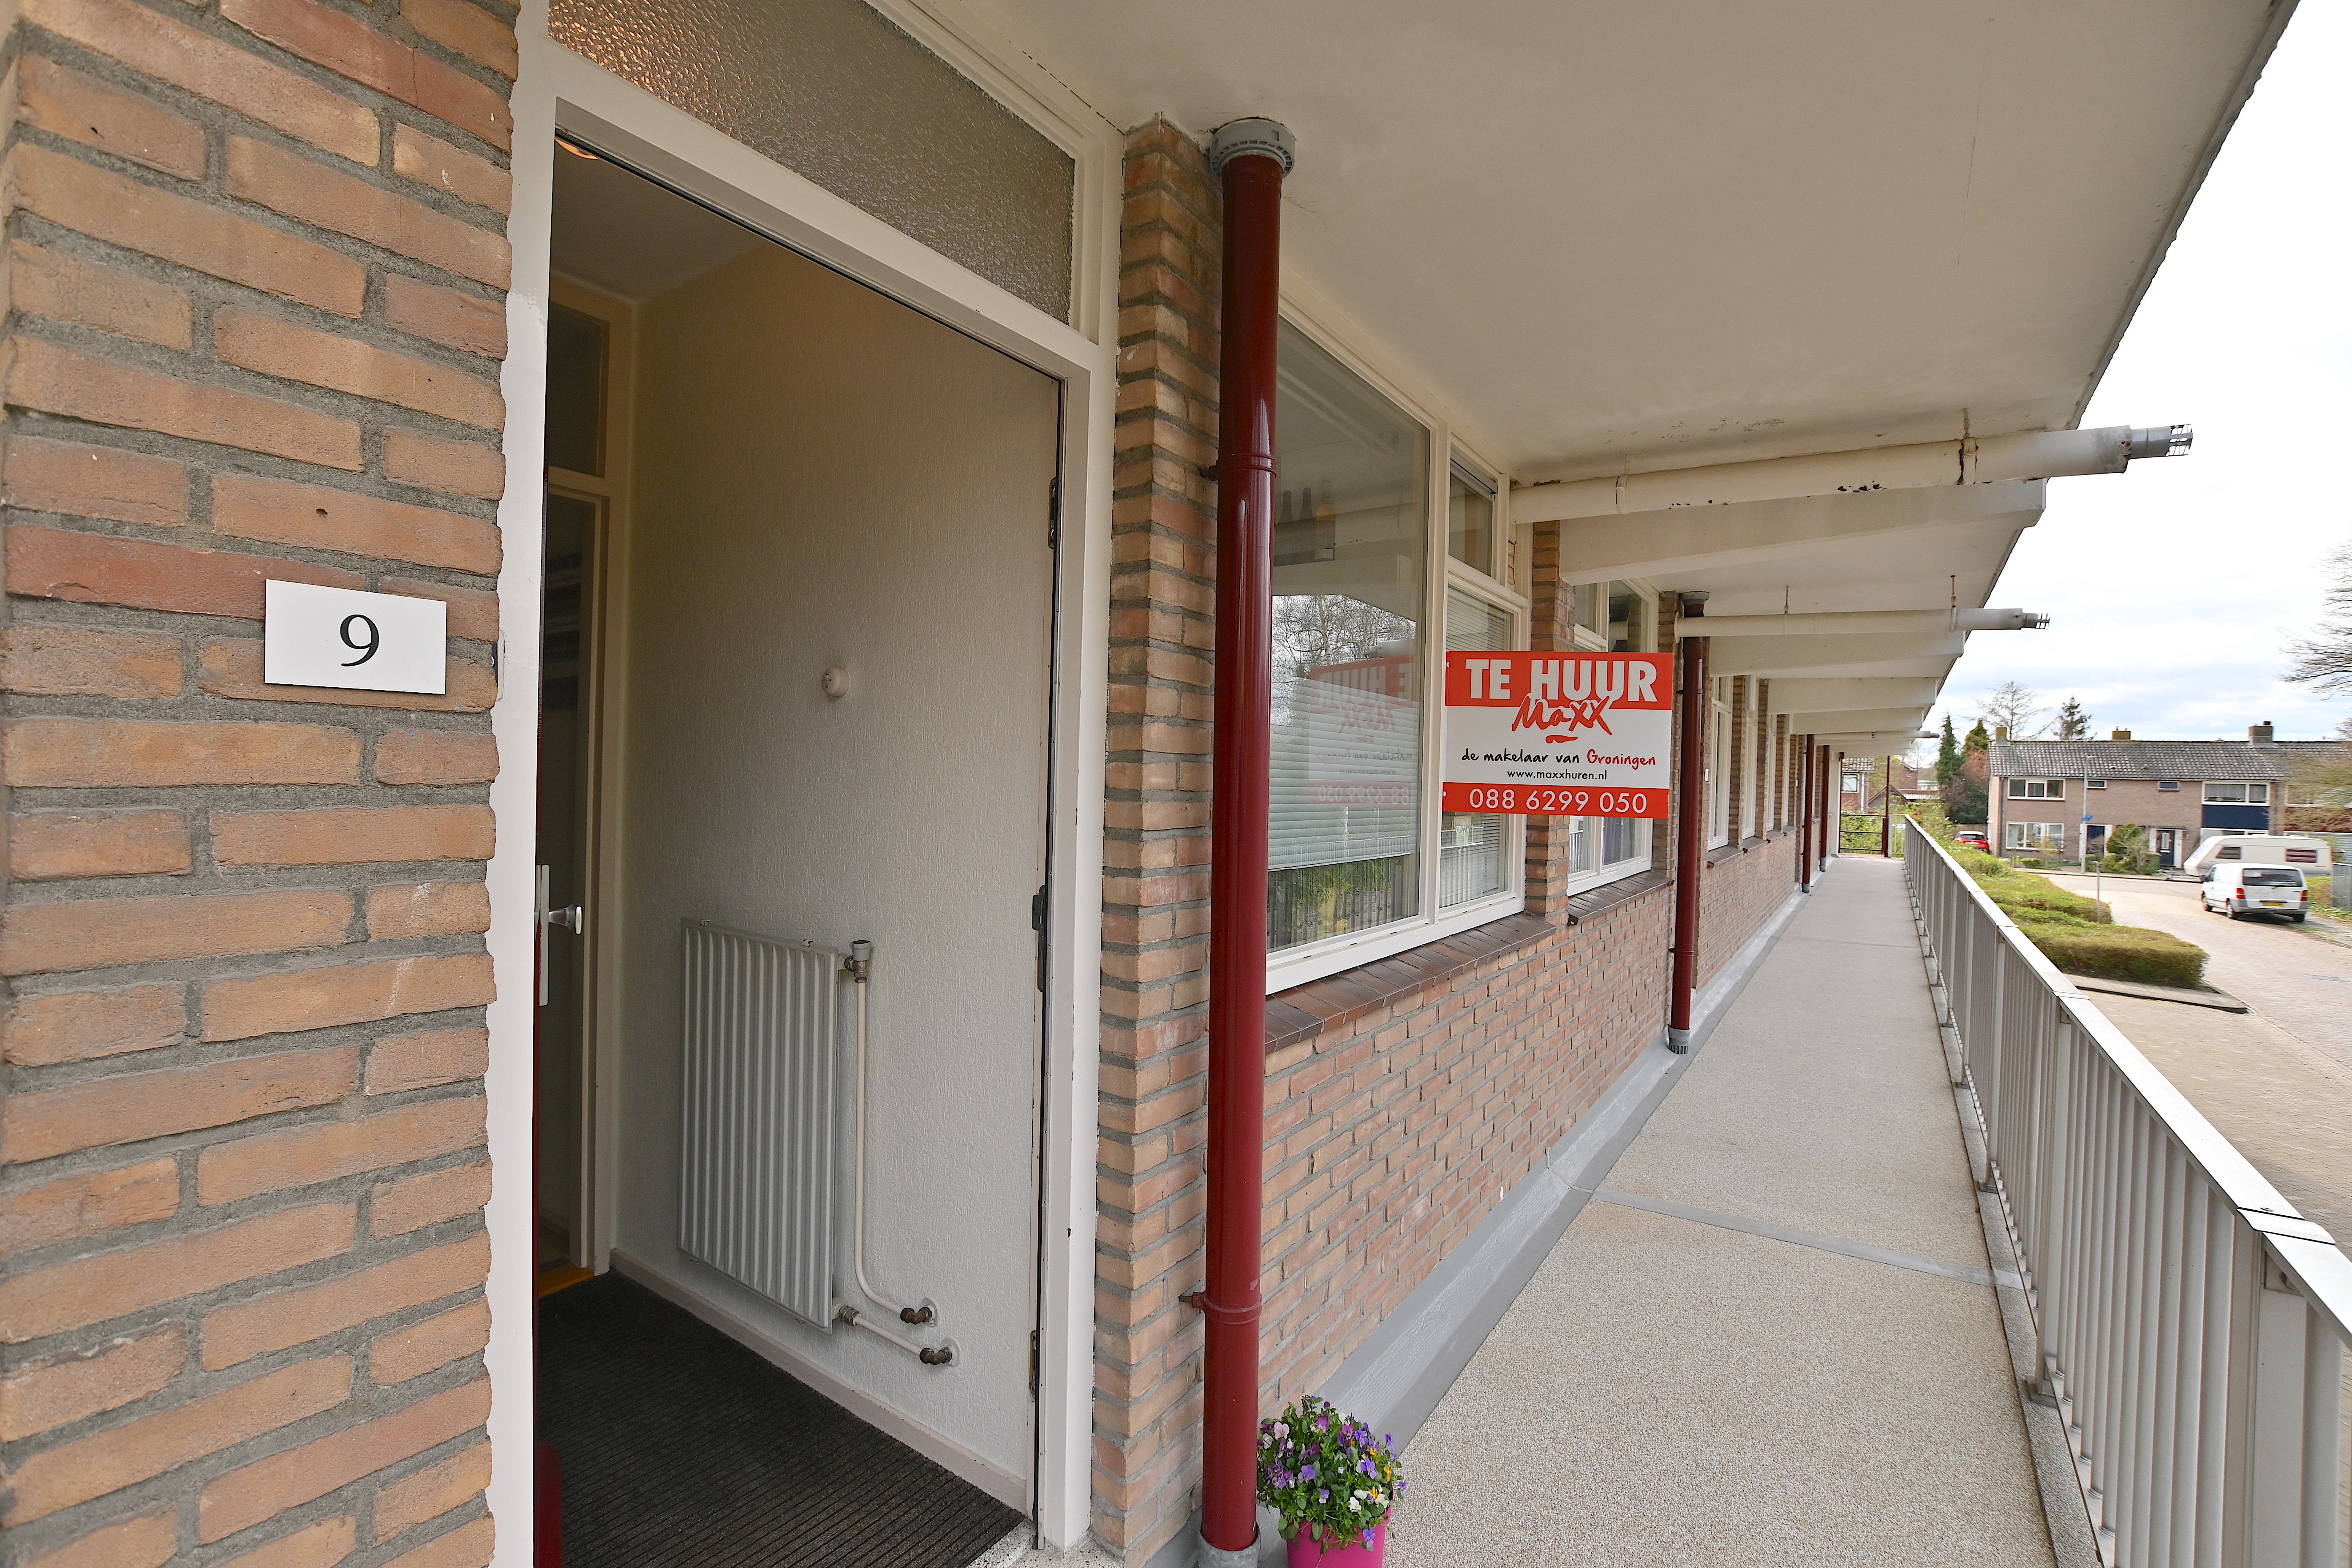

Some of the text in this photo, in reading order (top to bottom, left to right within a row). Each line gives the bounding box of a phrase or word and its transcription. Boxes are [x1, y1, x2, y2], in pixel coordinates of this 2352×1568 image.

[340, 614, 379, 667] 9
[1465, 659, 1658, 702] TE HUUR
[1511, 696, 1612, 735] Maxx
[1462, 747, 1655, 770] de makelaar van Groningen
[1507, 769, 1607, 780] www.maxxhuren.nl
[1469, 788, 1647, 813] 088 6299 050
